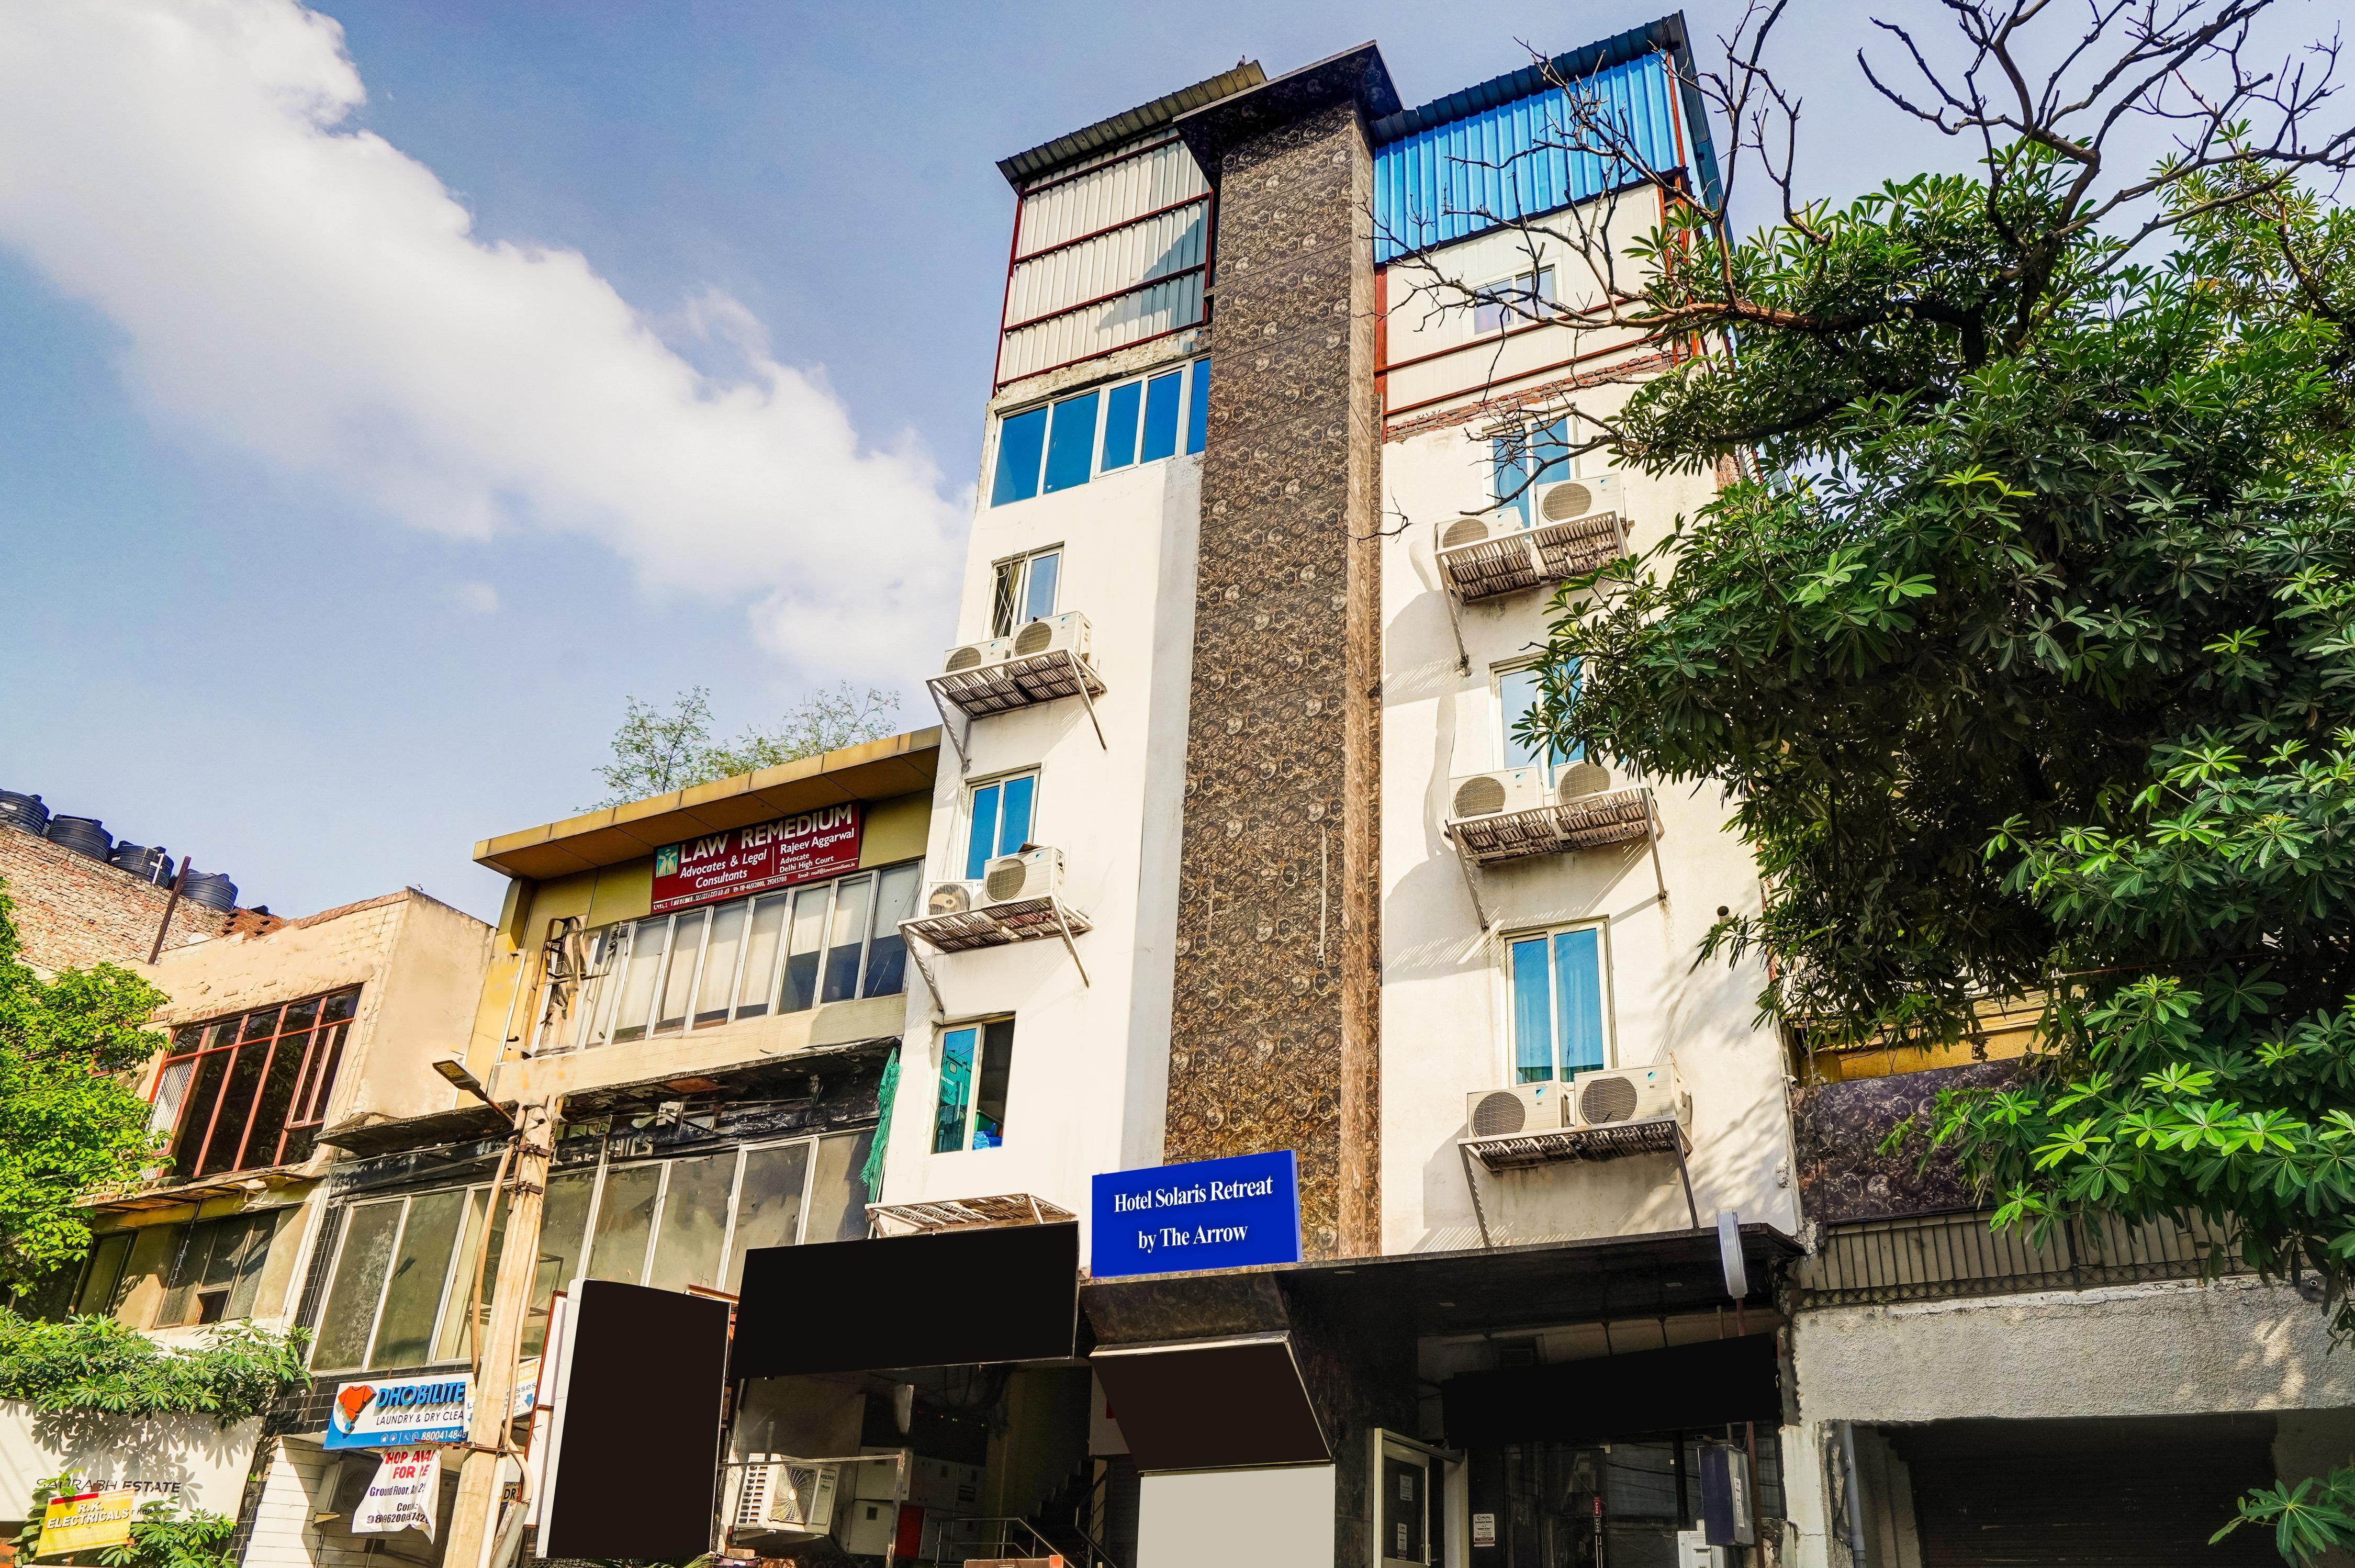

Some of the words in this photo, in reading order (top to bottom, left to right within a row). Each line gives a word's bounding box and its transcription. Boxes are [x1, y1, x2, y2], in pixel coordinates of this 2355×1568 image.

[680, 834, 728, 864] LAW
[741, 804, 853, 849] REMEDIUM
[780, 841, 810, 855] Rajeev
[811, 828, 854, 847] Aggarwal
[679, 861, 726, 879] Advocates
[730, 855, 738, 867] &
[742, 849, 767, 866] Legal
[779, 864, 796, 873] Delhi
[799, 860, 813, 869] High
[815, 856, 834, 865] Court
[780, 853, 810, 865] Advocate
[695, 869, 748, 889] Consultants
[1114, 1191, 1152, 1213] Hotel
[1155, 1184, 1206, 1207] Solaris
[1209, 1175, 1273, 1201] Retreat
[1138, 1231, 1157, 1253] by
[1160, 1227, 1190, 1247] The
[1193, 1225, 1248, 1244] Arrow
[375, 1382, 466, 1407] DHOBILITE
[376, 1414, 413, 1425] LAUNDRY
[416, 1414, 421, 1423] &
[424, 1412, 440, 1422] DRY
[443, 1410, 464, 1420] CLEA
[392, 1466, 416, 1479] FOR
[122, 1481, 182, 1493] ESTATE
[369, 1486, 393, 1496] Ground
[393, 1486, 409, 1495] Floor,
[77, 1502, 104, 1514] R.K.
[47, 1508, 130, 1529] ELECTRICALS
